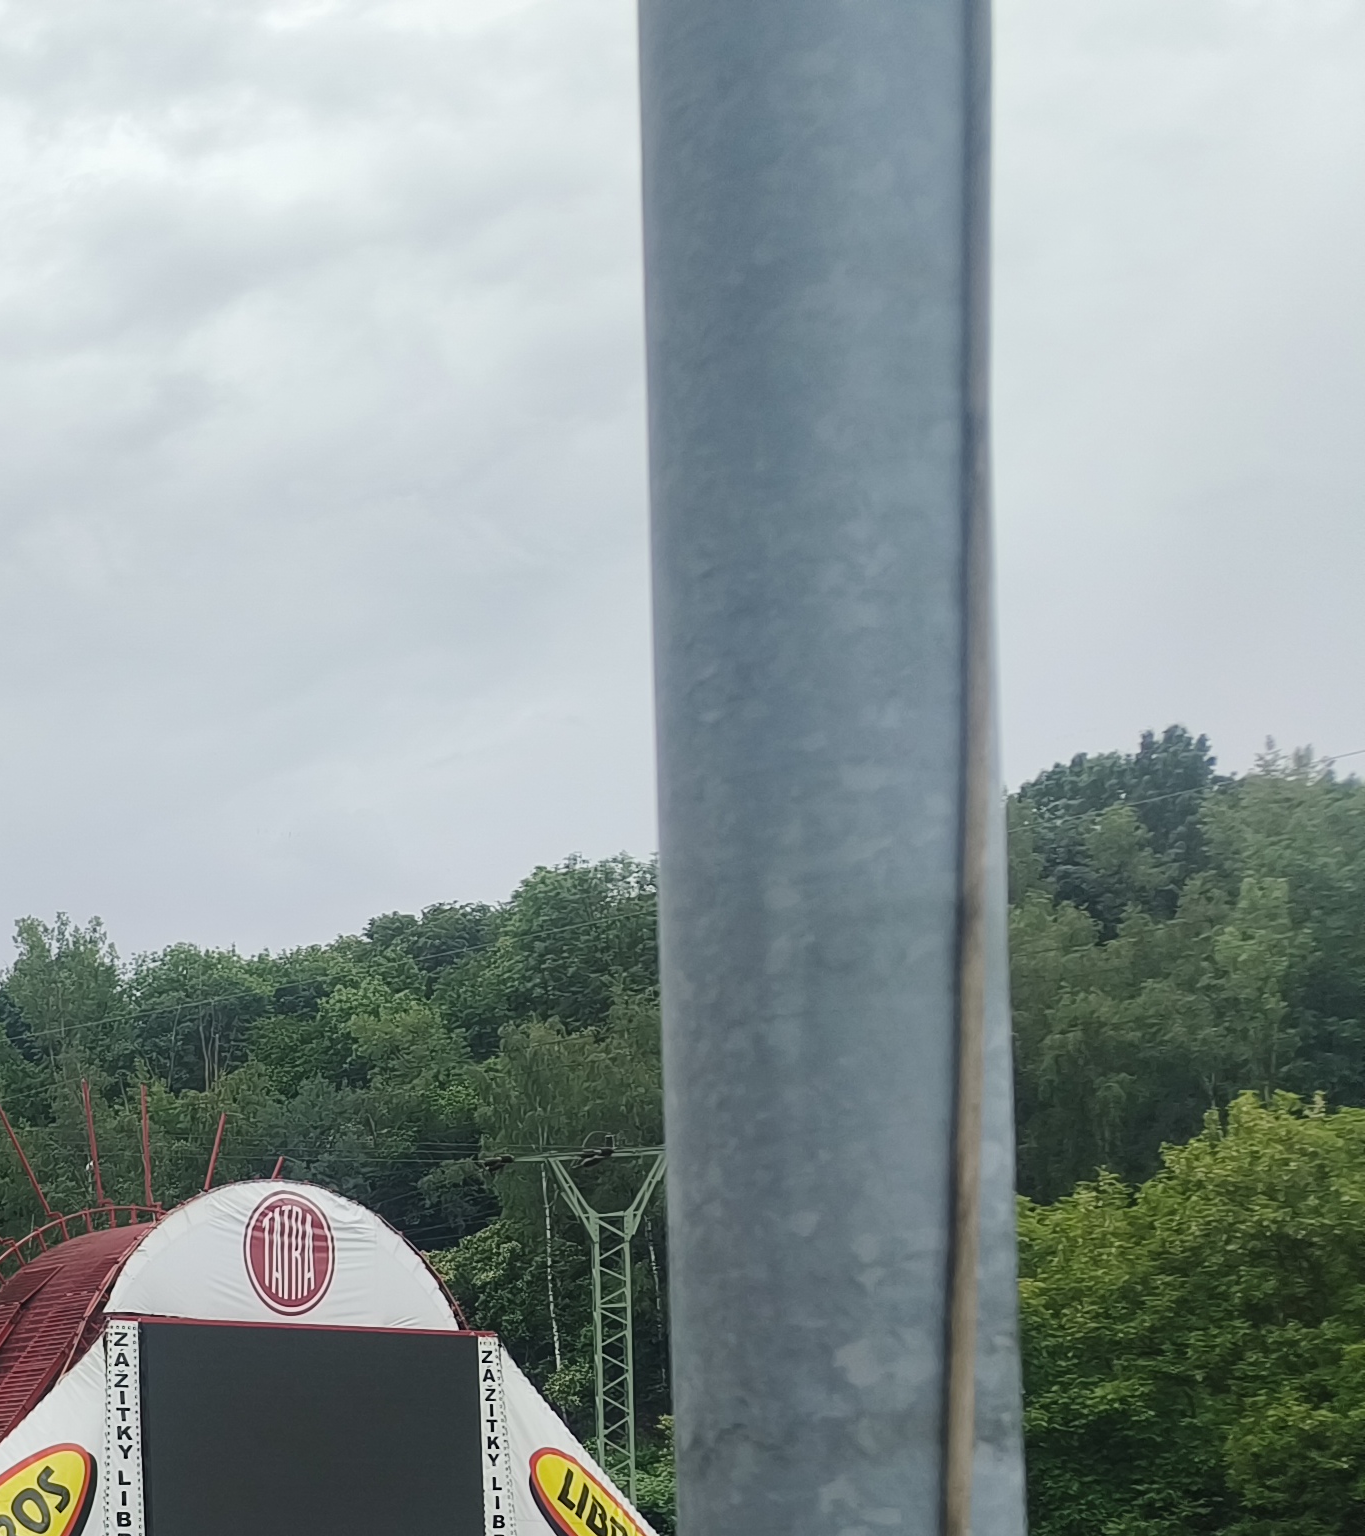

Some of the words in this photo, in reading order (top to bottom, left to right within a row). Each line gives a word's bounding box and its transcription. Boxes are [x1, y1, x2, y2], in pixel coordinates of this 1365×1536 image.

[262, 1205, 315, 1300] TATRA
[113, 1331, 133, 1460] ZÁŽITKY
[481, 1350, 500, 1467] ZÁŽITKY
